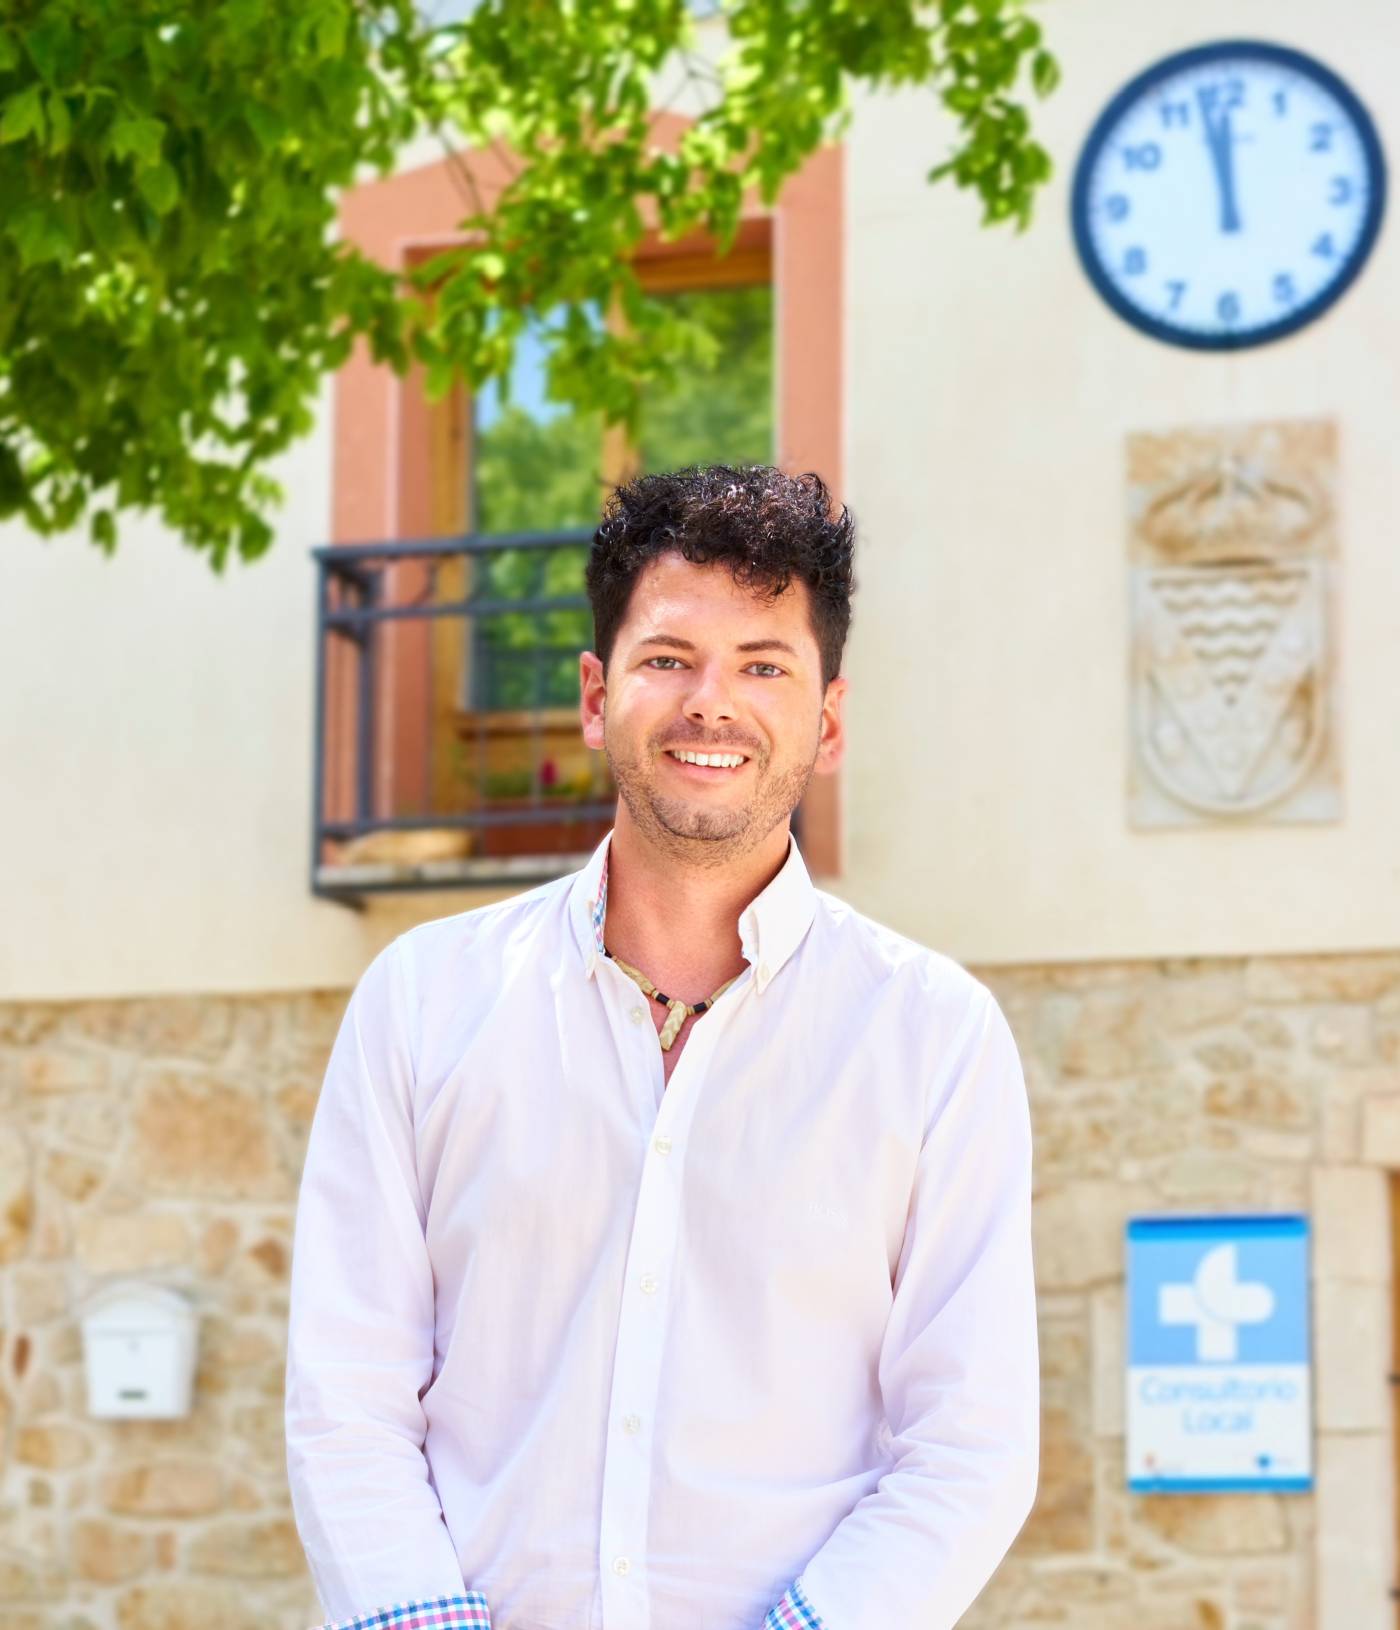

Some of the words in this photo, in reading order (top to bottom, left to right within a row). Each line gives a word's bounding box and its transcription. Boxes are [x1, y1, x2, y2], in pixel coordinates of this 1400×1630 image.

[1161, 101, 1190, 129] 11
[1271, 91, 1287, 116] 1
[1310, 122, 1333, 153] 2
[1123, 143, 1162, 171] 10
[1330, 176, 1352, 205] 3
[1106, 194, 1130, 222] 9
[1311, 232, 1334, 259] 4
[1124, 246, 1147, 276] 8
[1165, 280, 1187, 309] 7
[1273, 273, 1295, 303] 5
[1216, 291, 1239, 322] 6
[1139, 1375, 1298, 1405] Consultorio
[1181, 1406, 1254, 1433] Local
